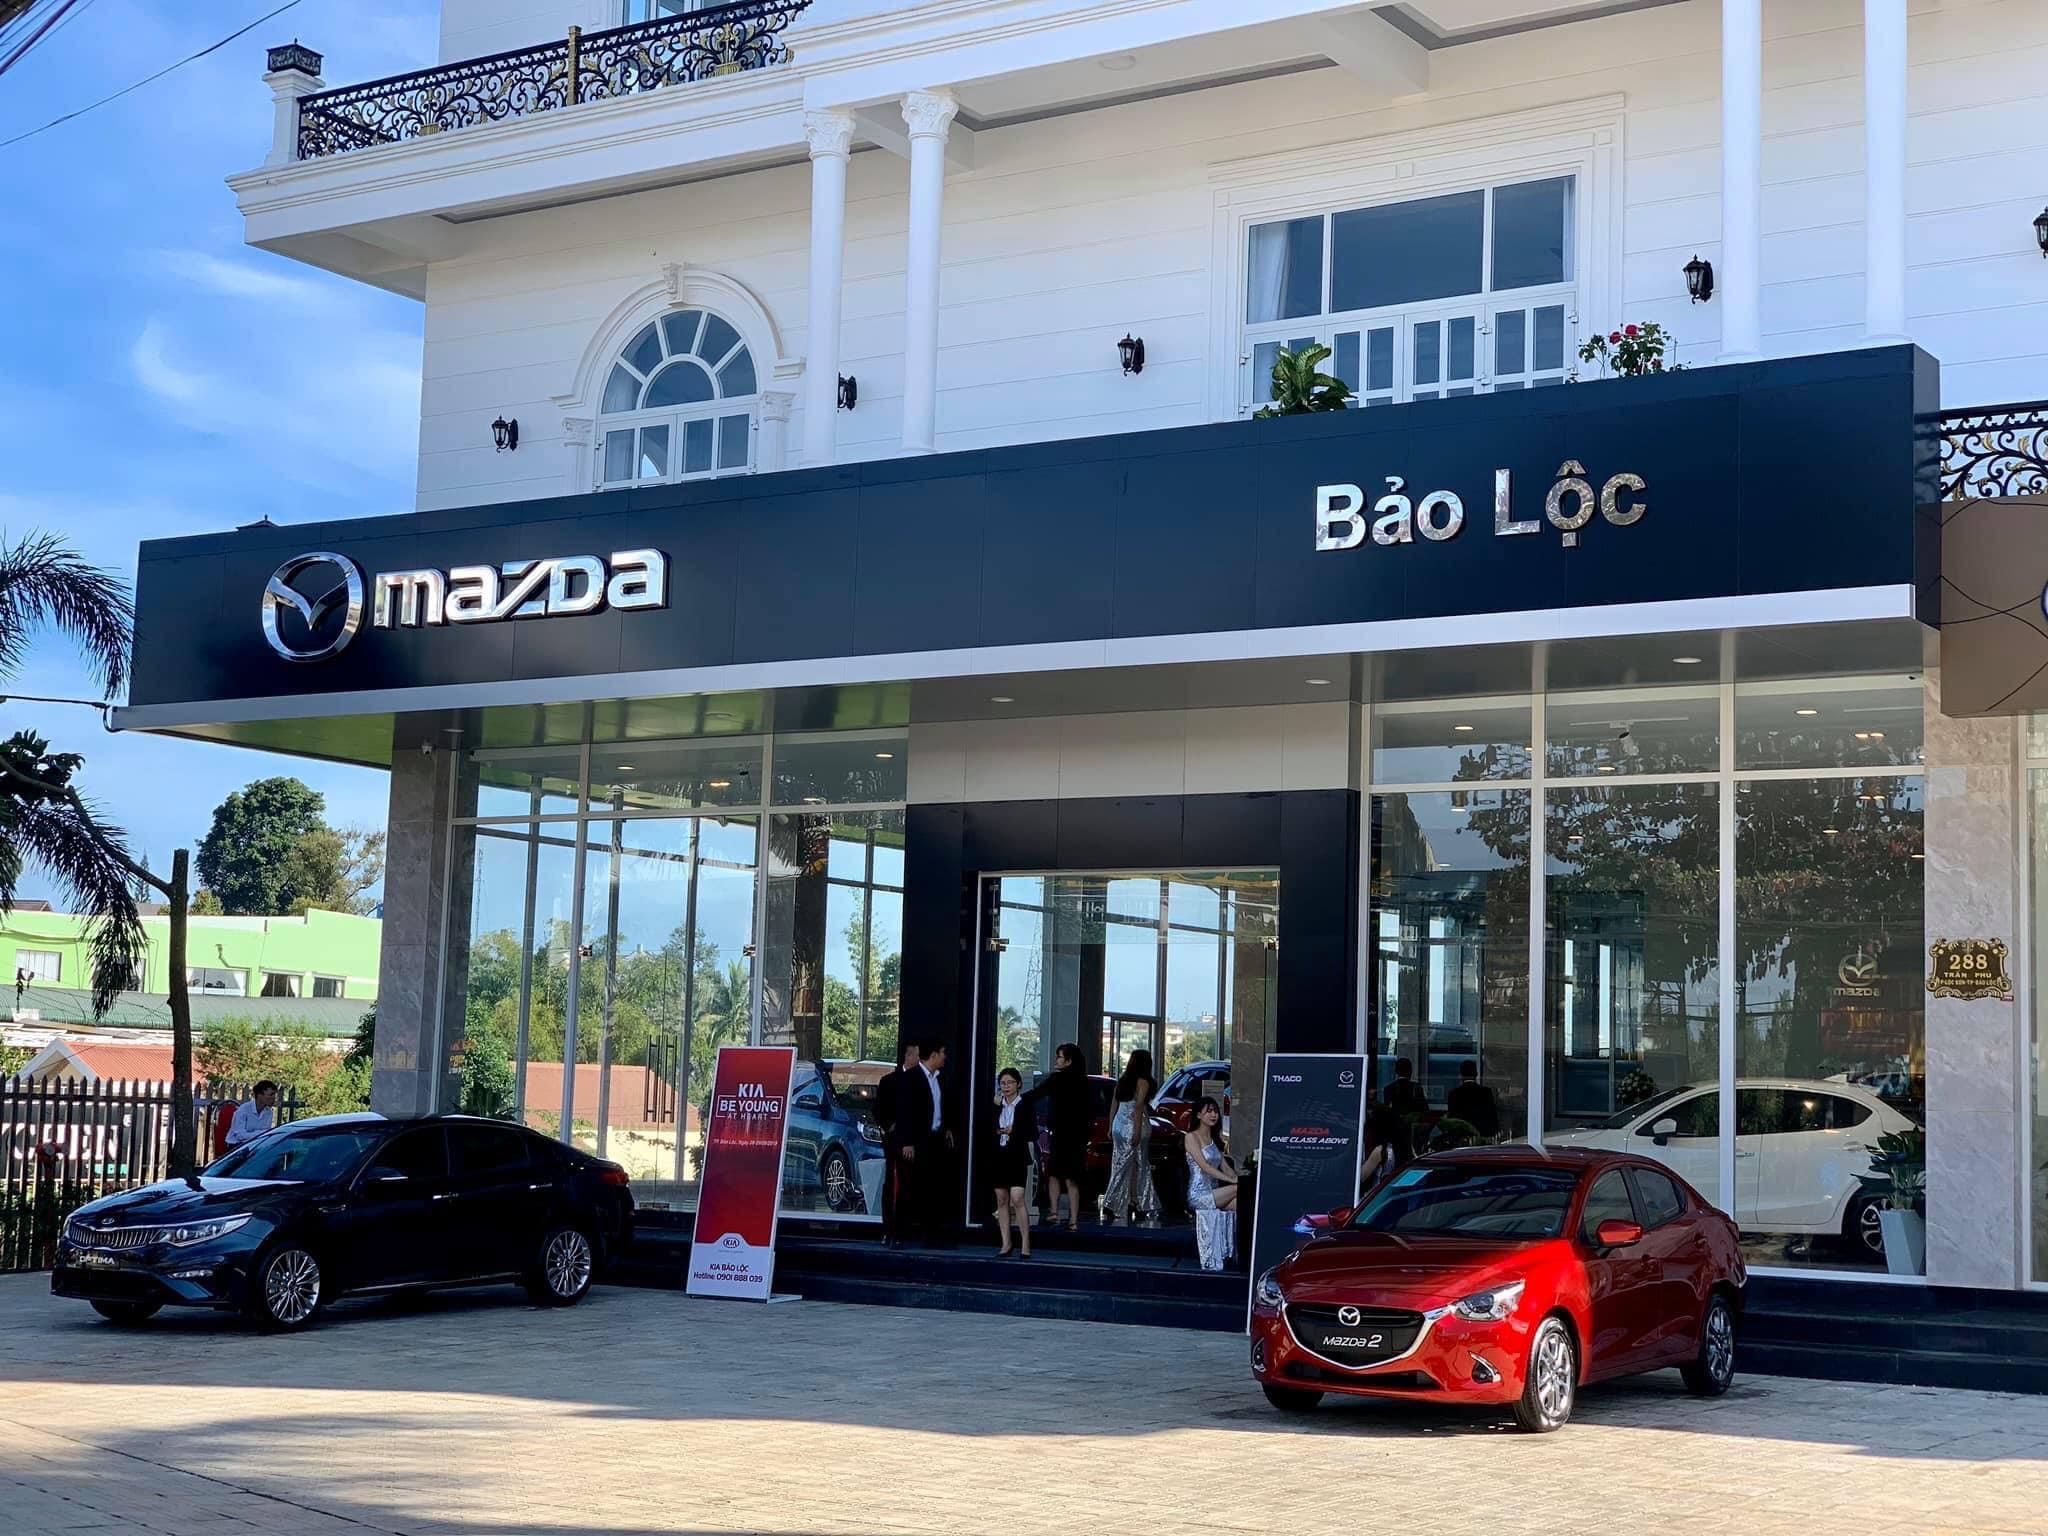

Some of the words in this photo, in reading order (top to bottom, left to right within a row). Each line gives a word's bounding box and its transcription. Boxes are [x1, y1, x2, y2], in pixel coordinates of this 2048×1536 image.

[1315, 475, 1464, 551] Bảo
[1495, 459, 1647, 547] Lộc
[1949, 953, 1988, 970] 288
[1272, 1074, 1302, 1082] THACO
[738, 1083, 764, 1098] KIA
[720, 1100, 737, 1112] BE
[738, 1100, 779, 1113] YOUNG
[727, 1112, 737, 1120] AT
[740, 1113, 768, 1121] HEART
[1289, 1136, 1318, 1144] CLASS
[1318, 1137, 1350, 1145] ABOVE
[710, 1263, 720, 1271] KIA
[1367, 1334, 1383, 1348] 2
